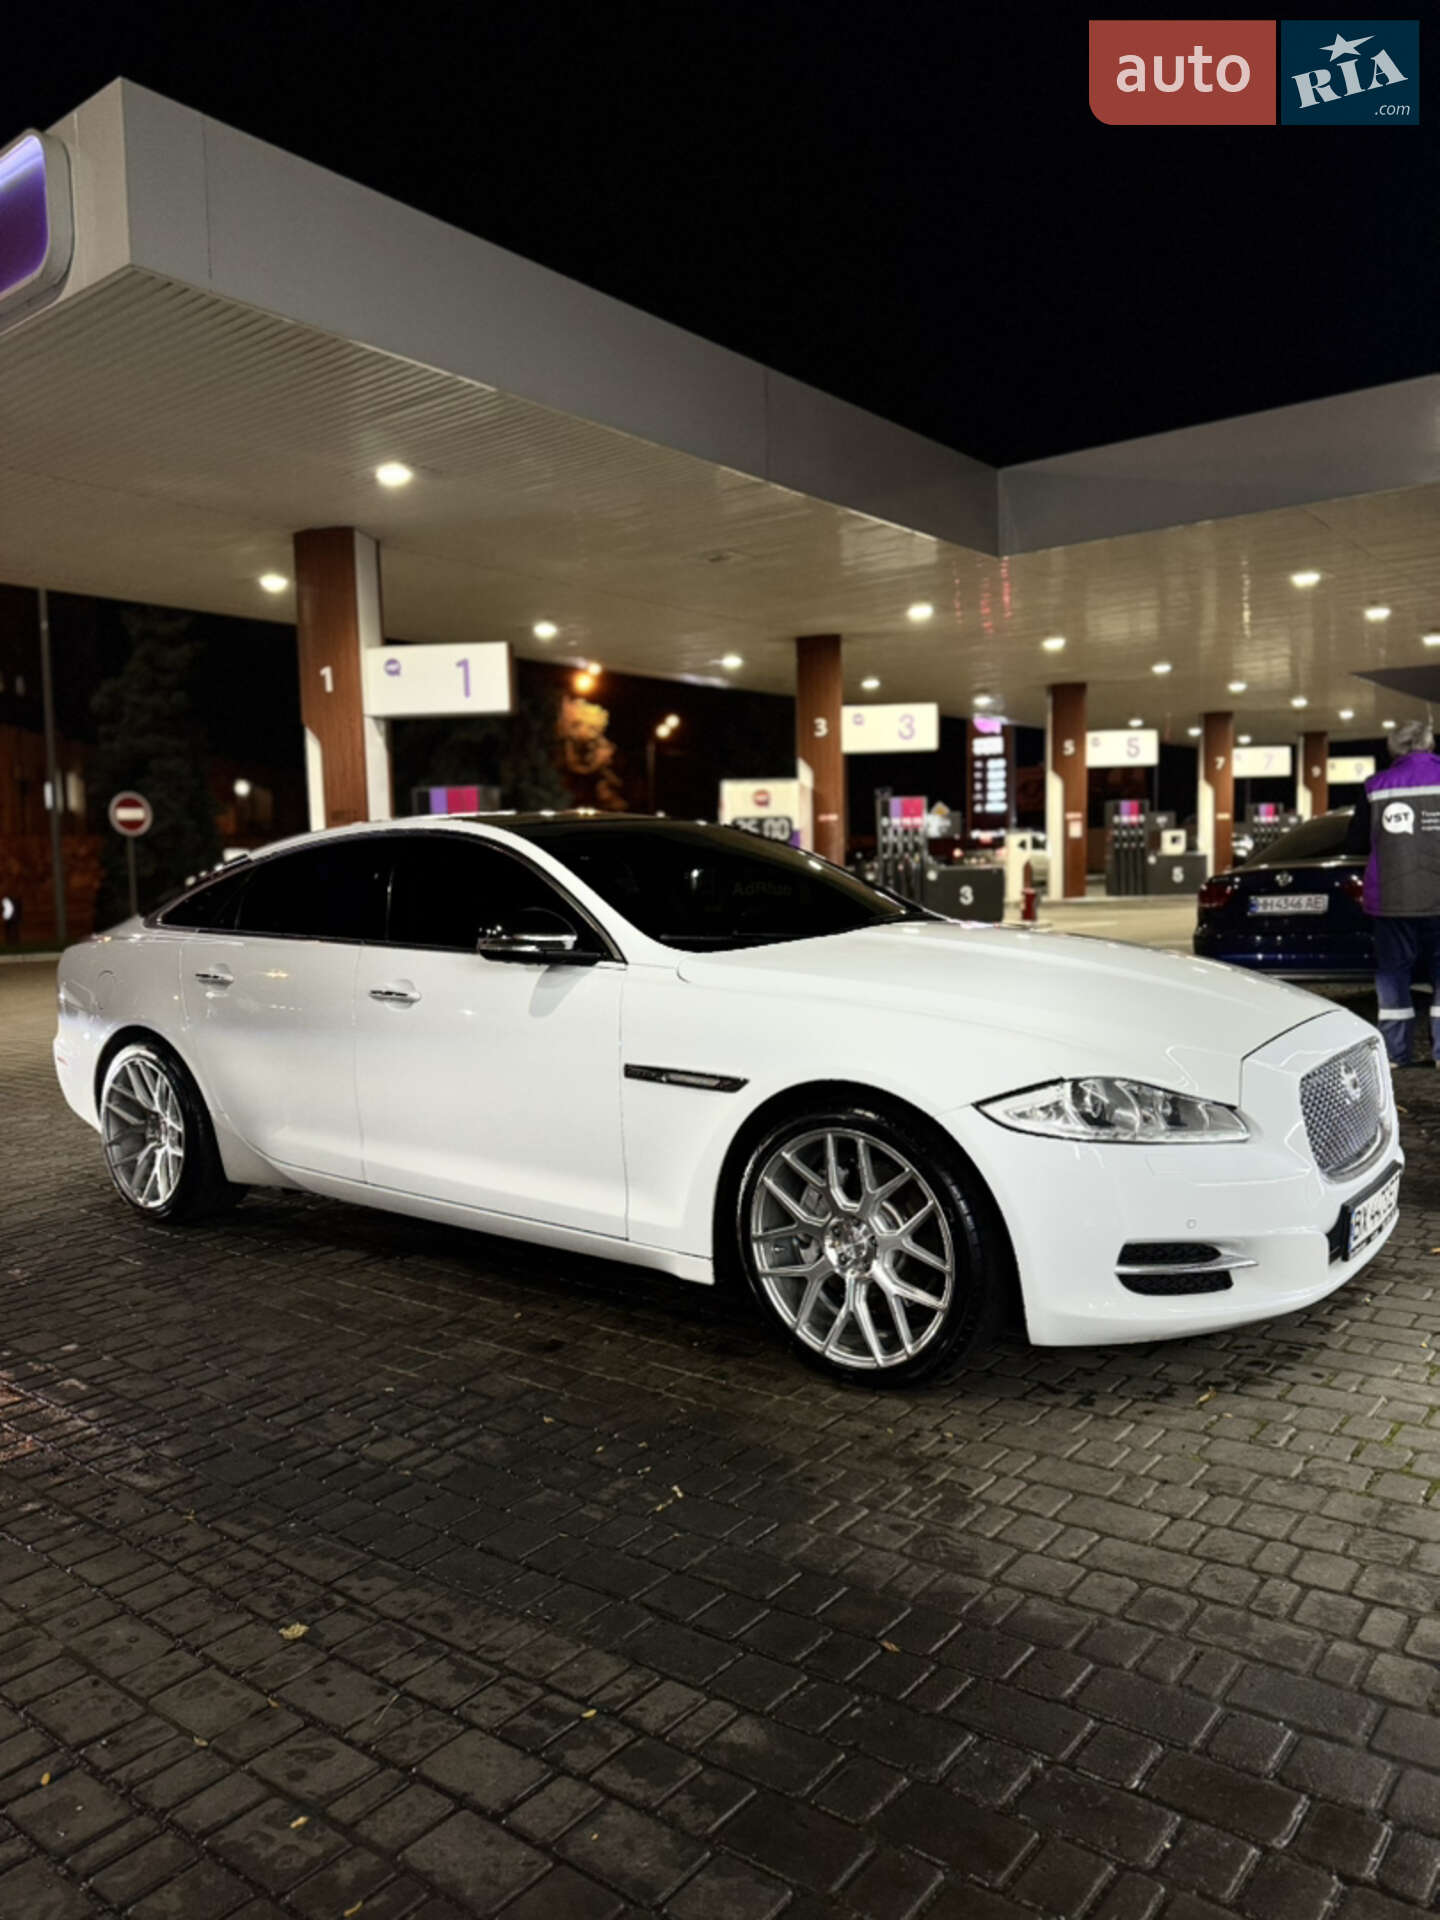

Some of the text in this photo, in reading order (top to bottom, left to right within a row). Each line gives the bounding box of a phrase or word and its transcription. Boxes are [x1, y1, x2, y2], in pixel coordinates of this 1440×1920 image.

[319, 665, 334, 693] 1
[456, 658, 471, 698] 1
[813, 717, 829, 738] 3
[897, 713, 916, 741] 3
[1063, 739, 1076, 756] 5
[1126, 737, 1141, 758] 5
[1215, 756, 1226, 771] 7
[1384, 811, 1410, 823] VST
[1171, 866, 1185, 883] 5
[959, 885, 974, 906] 3
